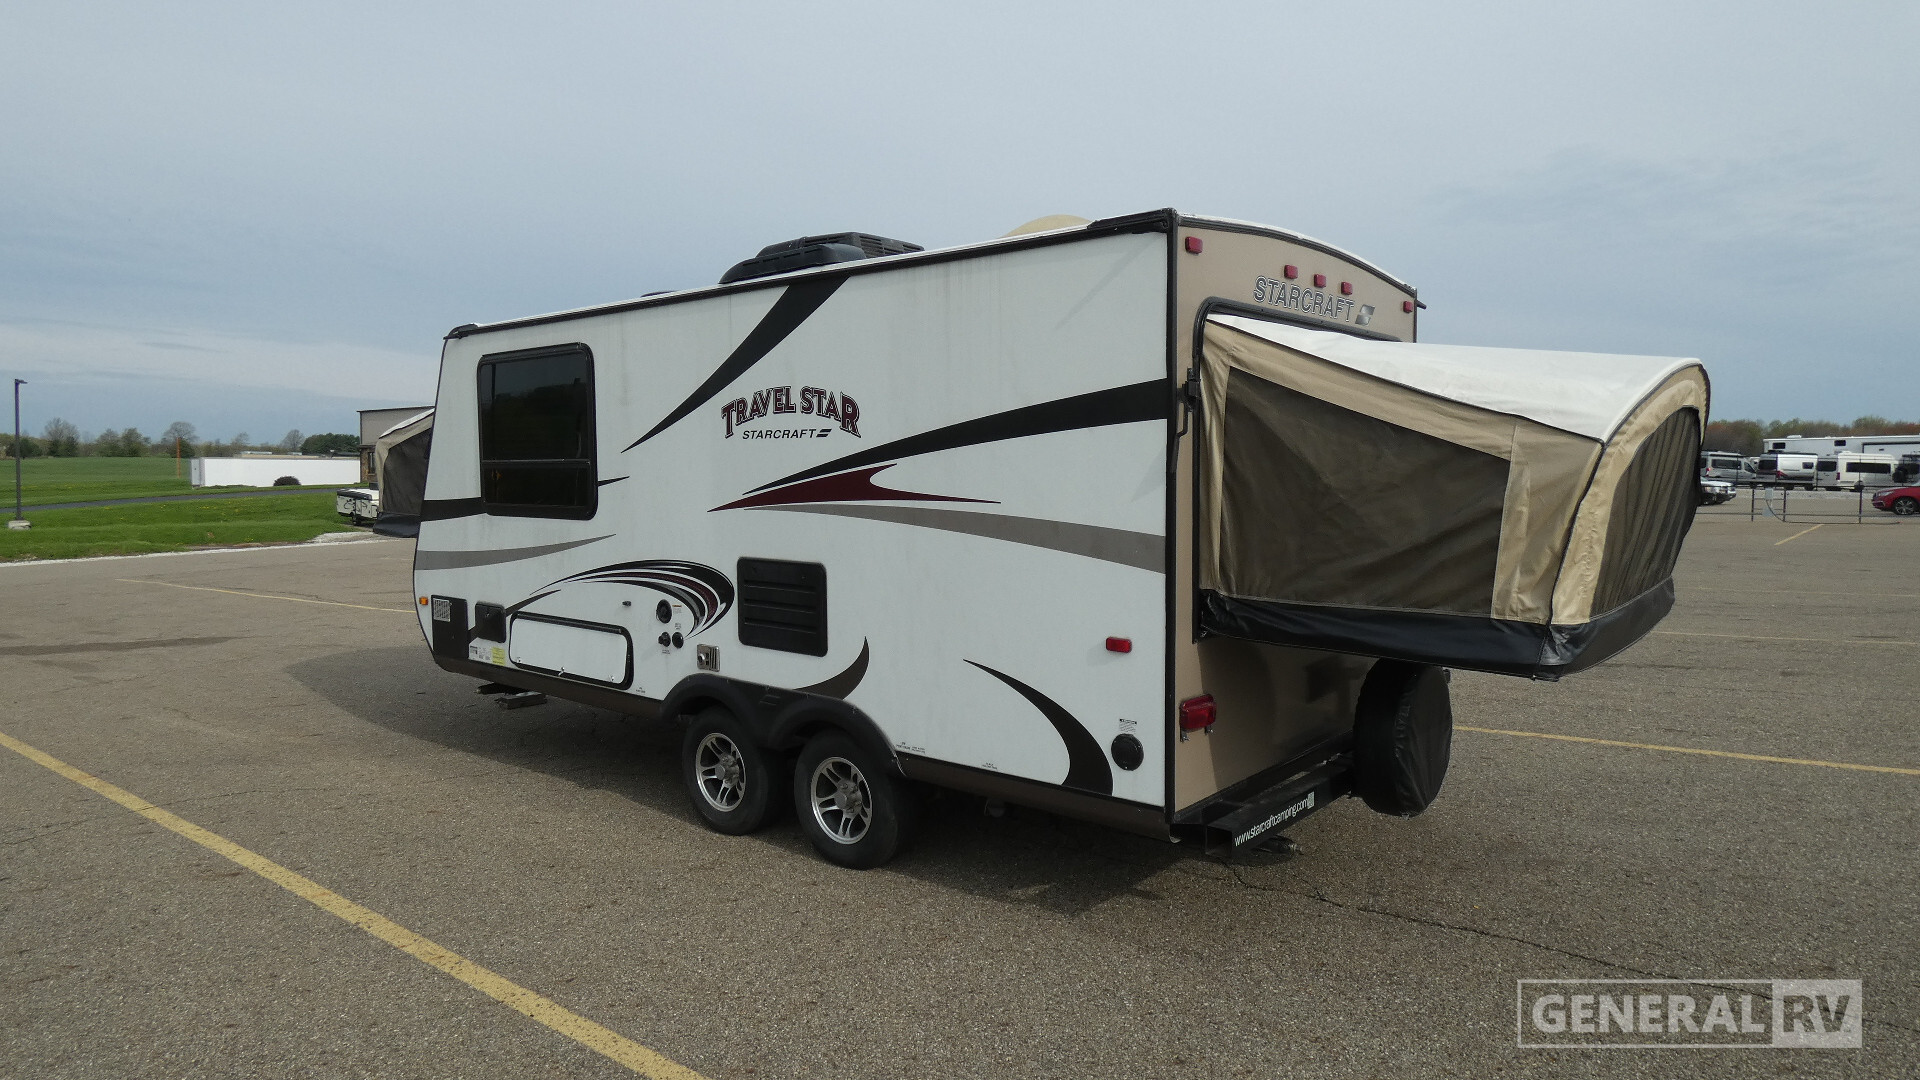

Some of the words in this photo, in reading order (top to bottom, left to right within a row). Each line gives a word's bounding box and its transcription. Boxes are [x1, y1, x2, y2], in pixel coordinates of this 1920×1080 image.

[1253, 275, 1355, 322] STARCRAFT
[721, 385, 797, 439] TRAVEL
[800, 385, 861, 438] STAR
[742, 428, 816, 440] STARCRAFT
[1234, 798, 1308, 847] www.starcraftcamping.com
